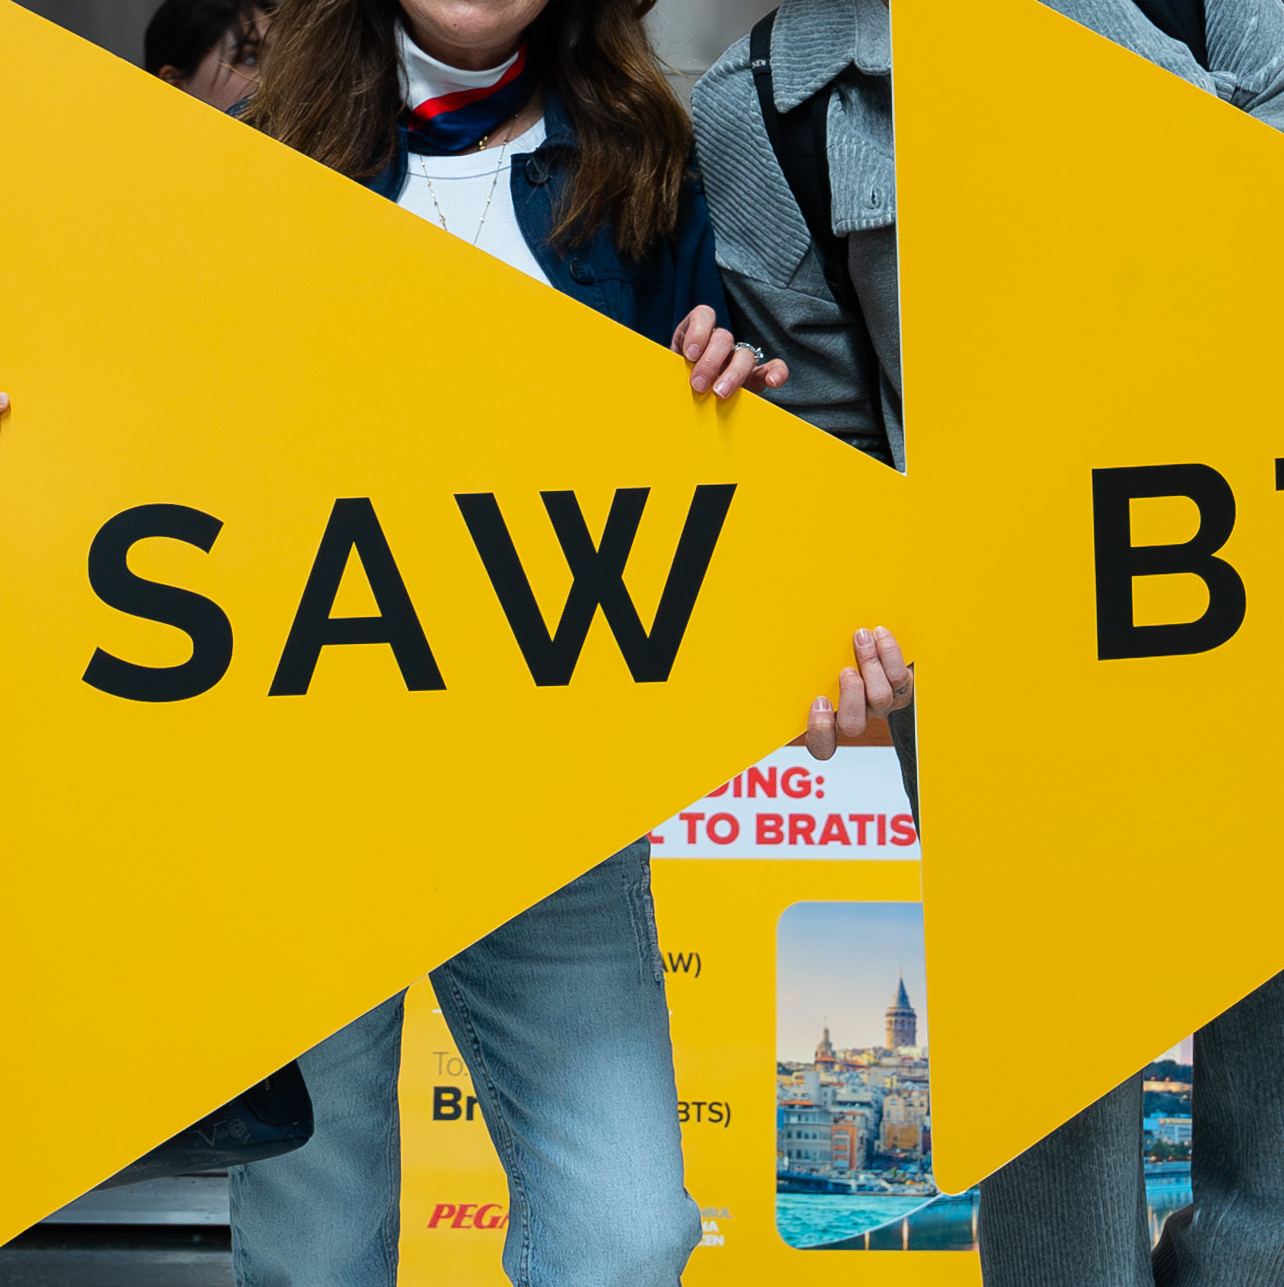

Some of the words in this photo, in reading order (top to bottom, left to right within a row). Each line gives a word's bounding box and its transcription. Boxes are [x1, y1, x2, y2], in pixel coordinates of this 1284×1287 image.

[81, 483, 738, 703] SAW
[679, 813, 740, 845] TO
[755, 814, 917, 846] BRATIS
